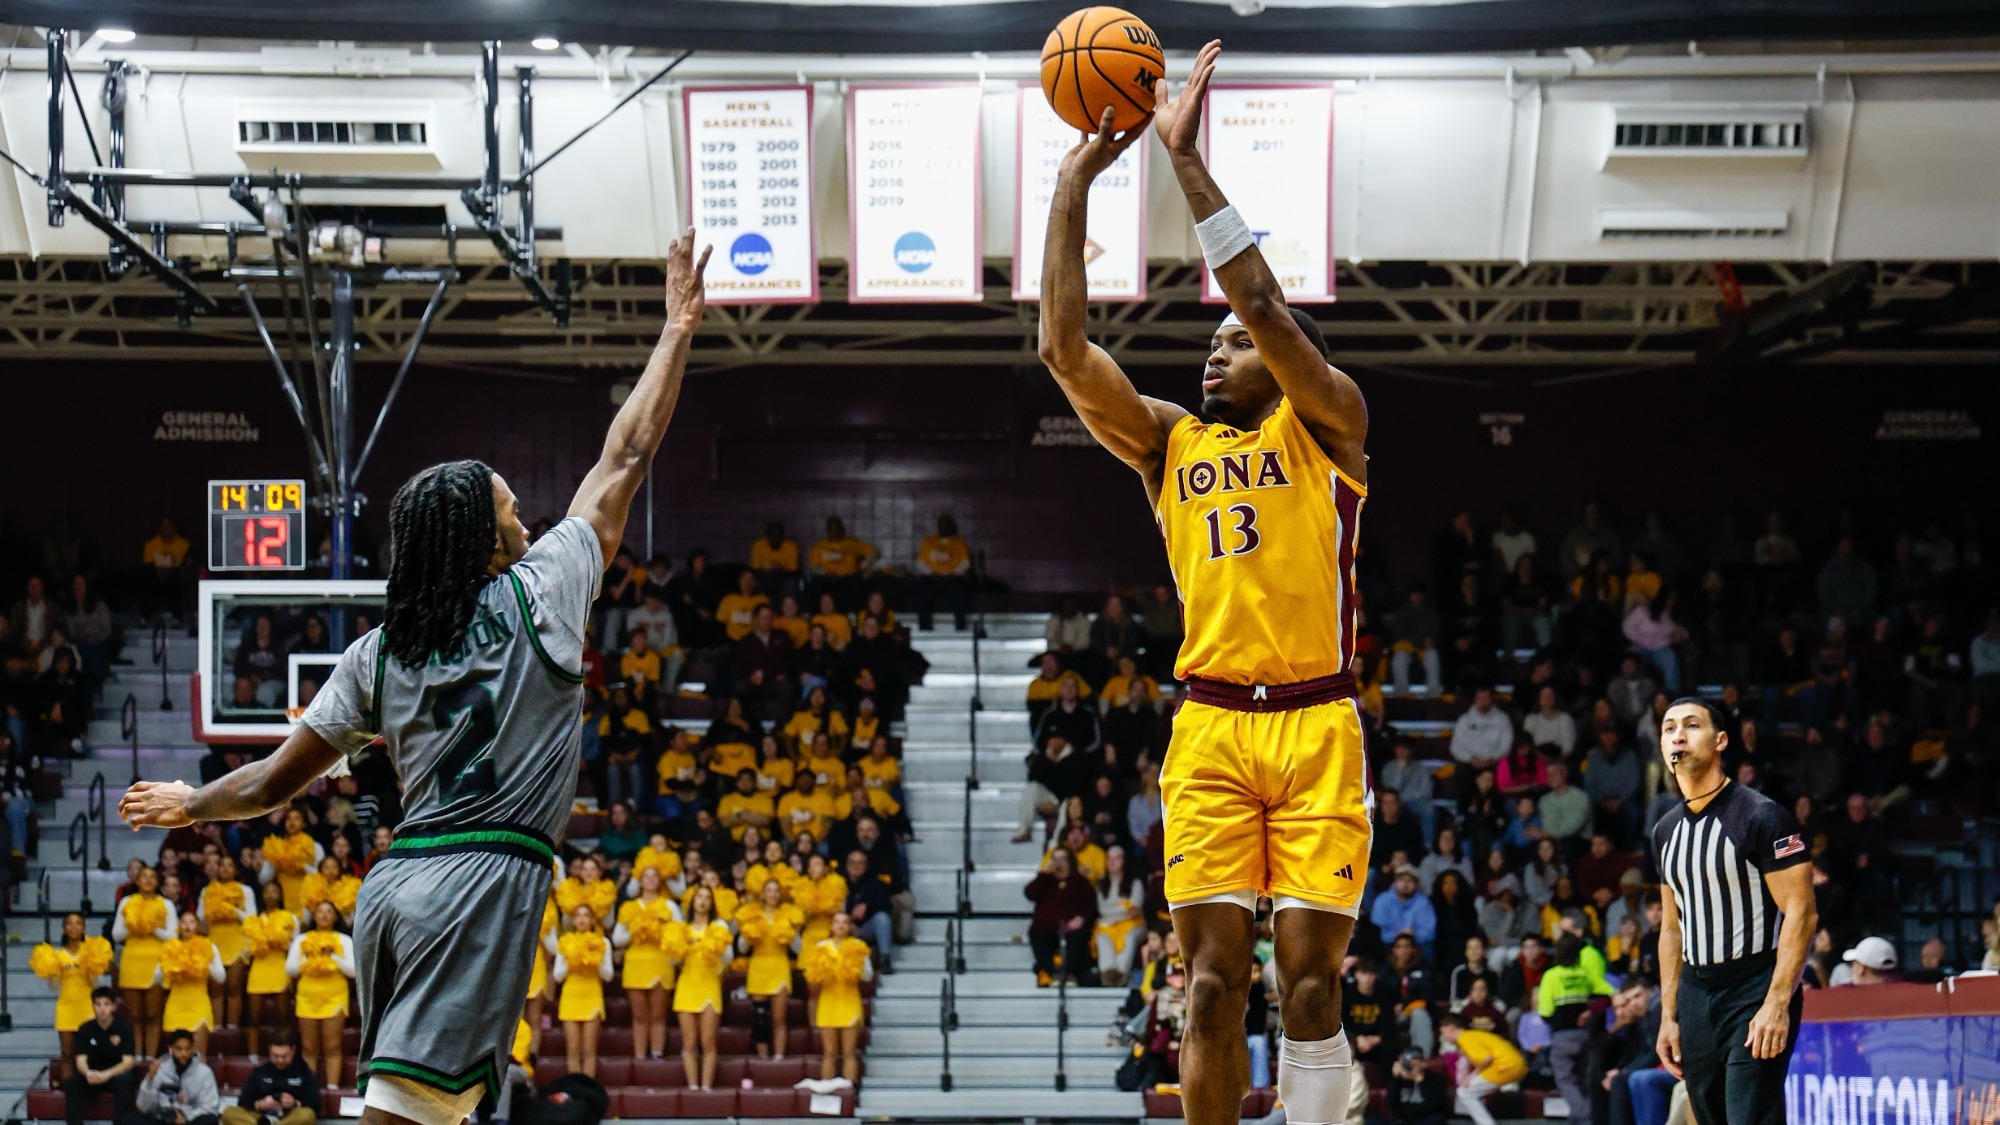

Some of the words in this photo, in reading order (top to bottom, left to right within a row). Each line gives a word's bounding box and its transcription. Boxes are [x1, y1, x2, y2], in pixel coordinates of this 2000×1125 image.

[1133, 66, 1157, 94] NC
[725, 102, 771, 112] MEN'S
[703, 117, 794, 128] BASKETBALL
[700, 142, 736, 153] 1979
[756, 140, 799, 152] 2000
[868, 140, 904, 151] 2016
[1252, 140, 1284, 151] 2011
[700, 160, 738, 172] 1980
[760, 159, 797, 171] 2001
[868, 158, 903, 170] 2017
[701, 178, 737, 190] 1984
[757, 177, 799, 189] 2006
[868, 177, 904, 189] 2018
[702, 197, 738, 209] 1985
[761, 196, 797, 208] 2012
[868, 195, 905, 208] 2019
[703, 215, 738, 227] 1998
[762, 214, 797, 226] 2013
[704, 279, 802, 290] APPEARANCES
[866, 278, 965, 288] APPEARANCES
[162, 411, 249, 427] GENERAL
[154, 426, 259, 442] ADMISSION
[1491, 425, 1512, 446] 16
[1175, 450, 1292, 504] IONA
[1204, 502, 1261, 562] 13
[245, 517, 288, 567] 12
[430, 682, 497, 804] 2
